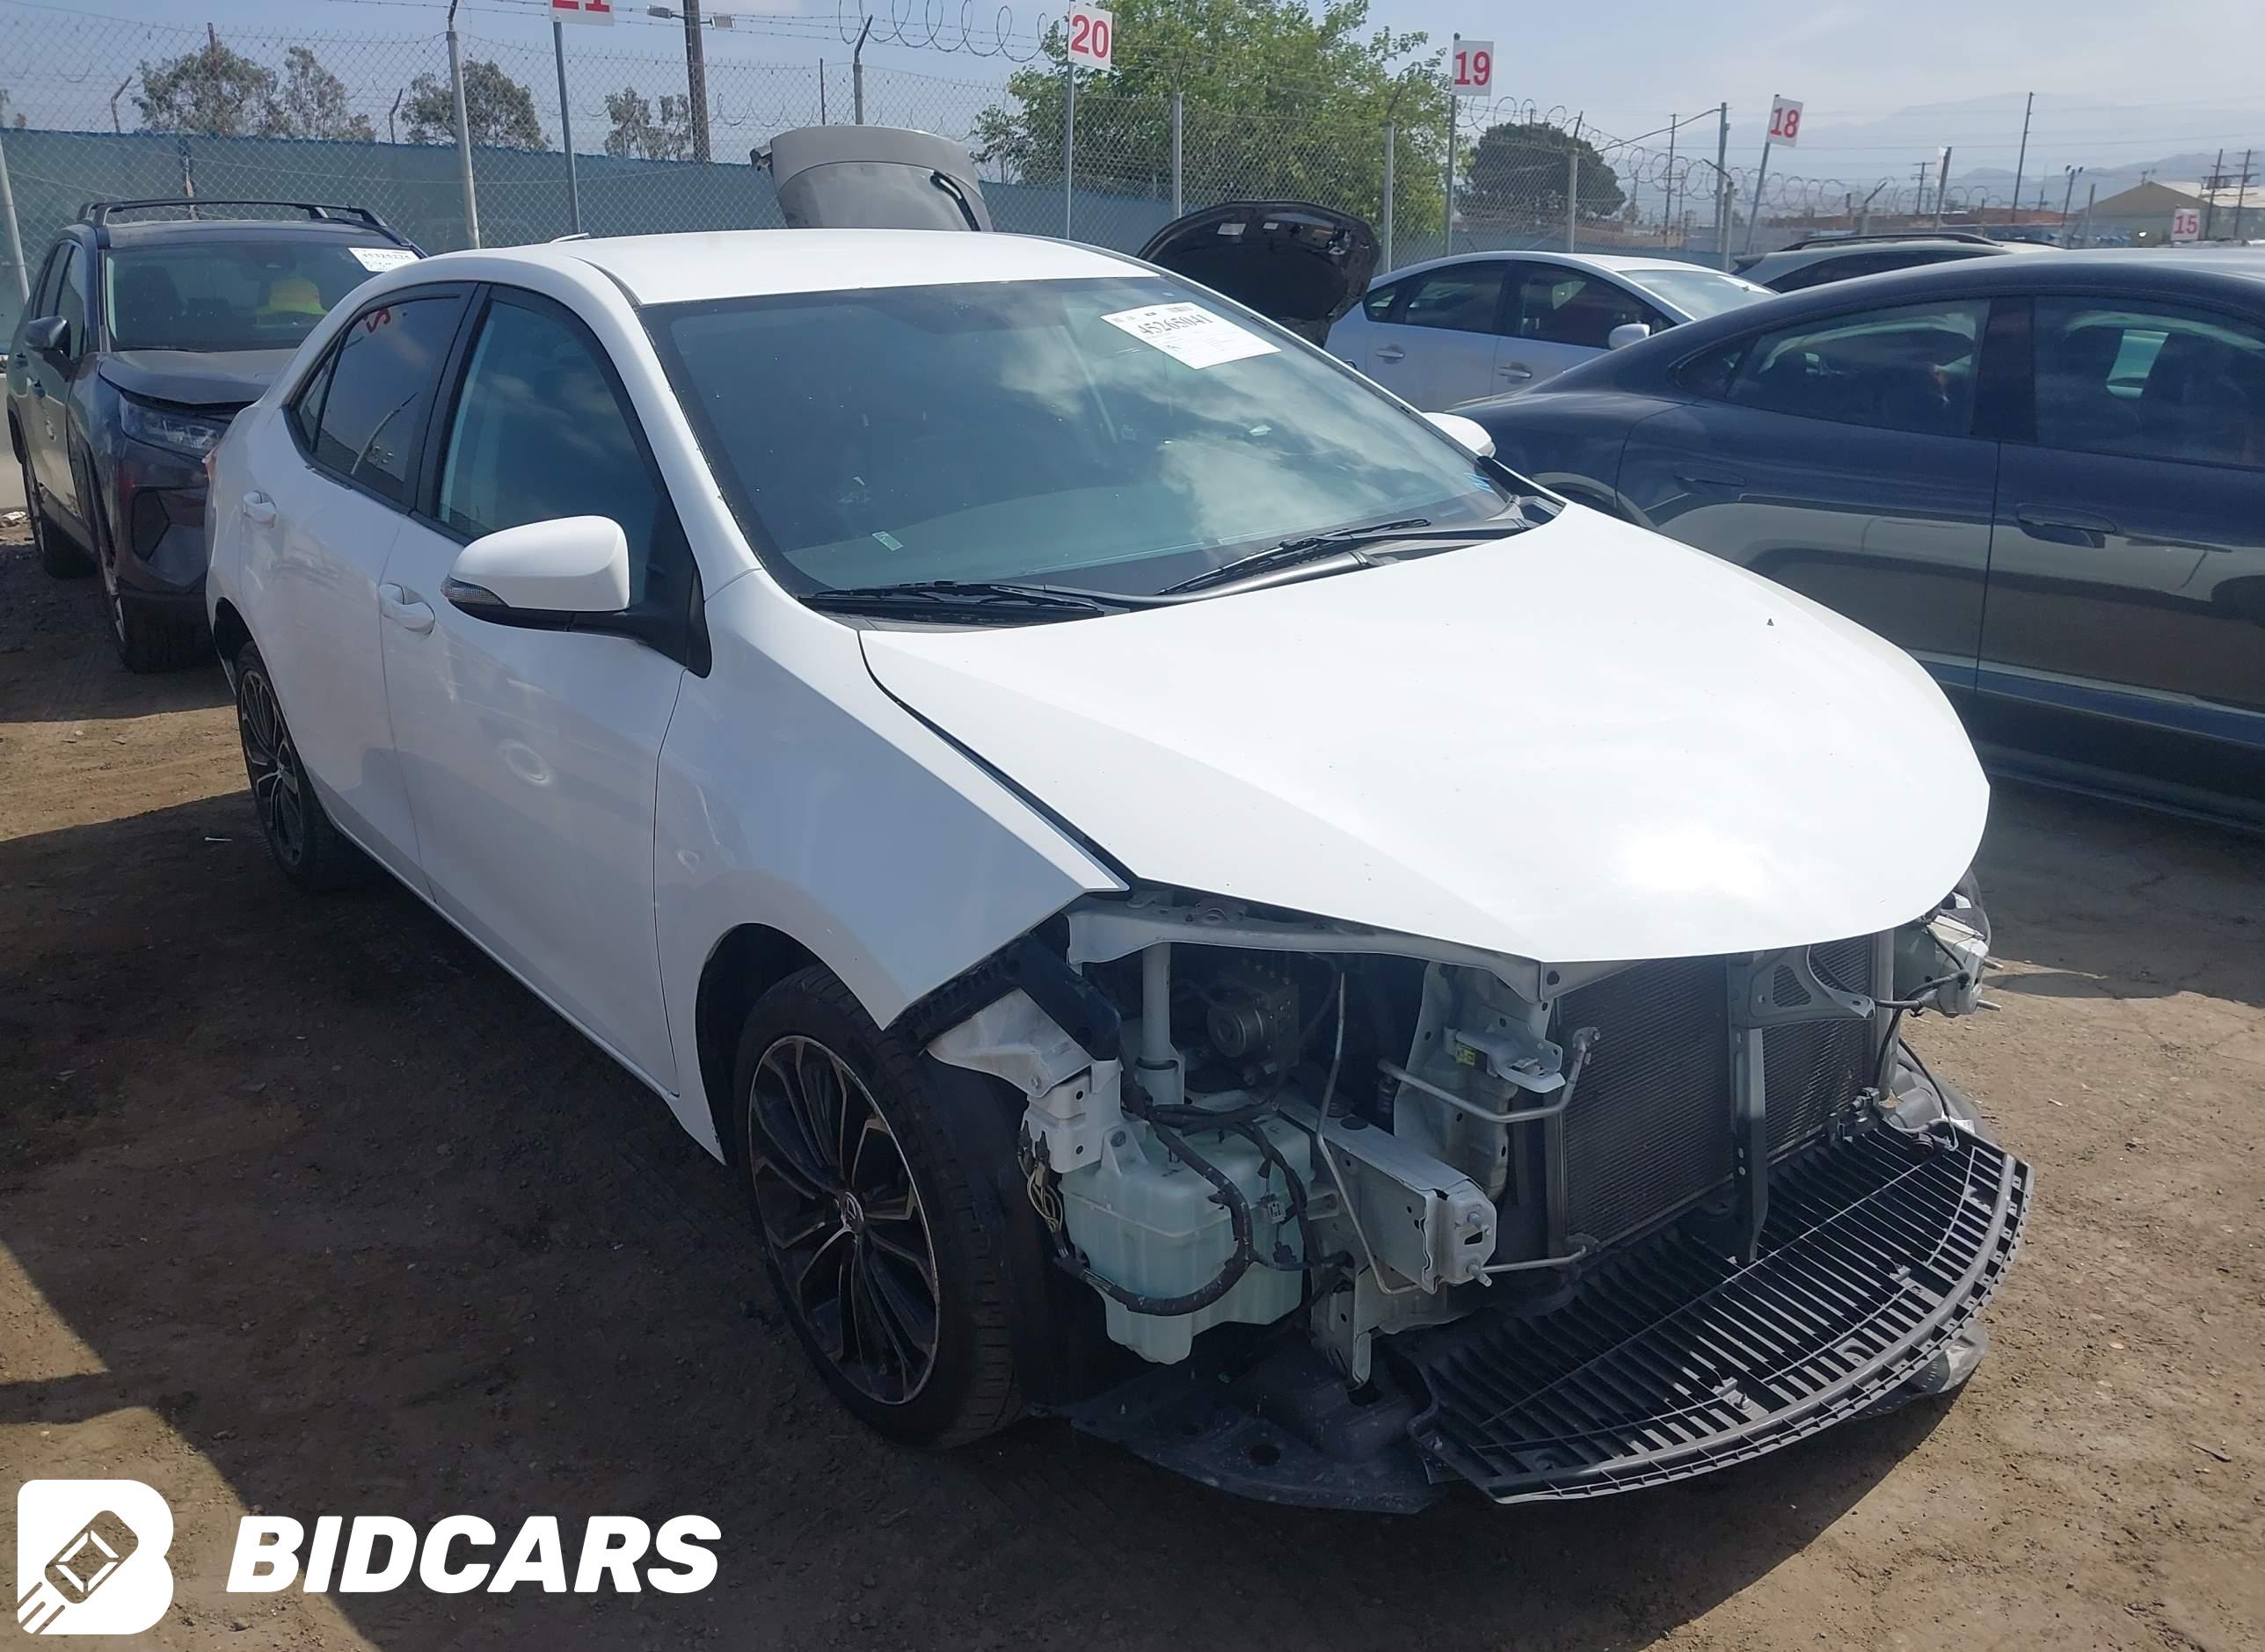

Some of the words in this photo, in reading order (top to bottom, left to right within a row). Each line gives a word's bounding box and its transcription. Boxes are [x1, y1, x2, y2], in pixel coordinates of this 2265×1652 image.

[1071, 14, 1109, 58] 20
[1454, 51, 1490, 85] 19
[1771, 107, 1799, 138] 18
[2174, 215, 2197, 234] 15
